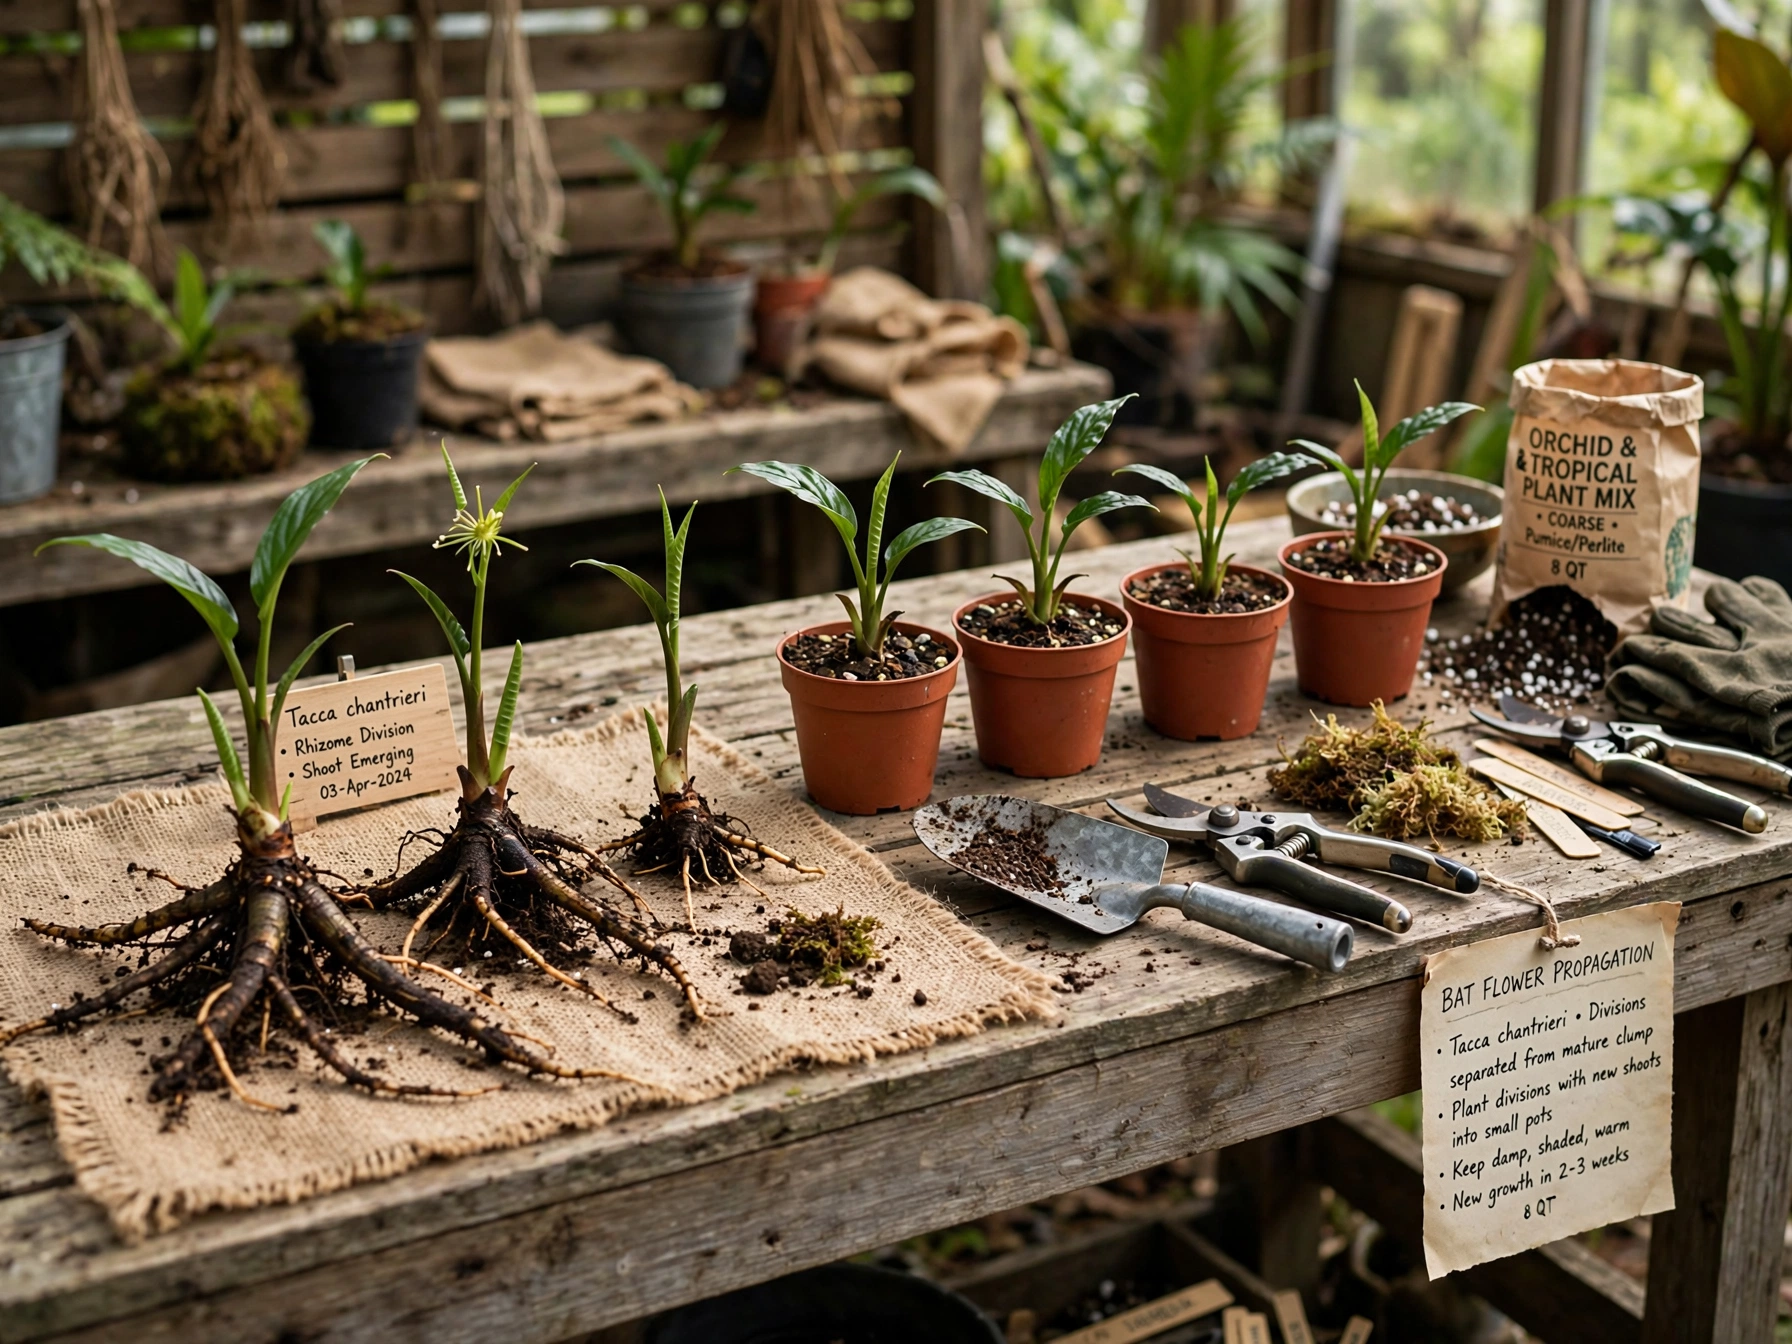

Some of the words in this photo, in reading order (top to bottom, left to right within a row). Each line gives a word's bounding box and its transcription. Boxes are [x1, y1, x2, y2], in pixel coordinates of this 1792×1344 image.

[1529, 427, 1613, 457] ORCHID
[1620, 436, 1637, 458] &
[1530, 453, 1637, 484] TROPICAL
[1523, 477, 1588, 507] PLANT
[1594, 487, 1637, 509] MIX
[1548, 511, 1605, 531] COARSE
[1525, 527, 1625, 554] Pumice/Perlite
[1551, 559, 1560, 575] 8
[1565, 560, 1587, 579] QT
[285, 706, 338, 728] Tacca
[346, 684, 427, 717] chantrieri
[295, 735, 353, 756] Rhizome
[360, 722, 414, 743] Division
[302, 757, 343, 779] Shoot
[350, 746, 414, 769] Emerging
[320, 767, 412, 799] 03-Apr-2024
[1441, 982, 1476, 1013] BAT
[1482, 966, 1544, 1000] FLOWER
[1553, 941, 1655, 984] PROPAGATION
[1449, 1034, 1490, 1056] Tacca
[1497, 1009, 1568, 1044] chantrieri
[1588, 996, 1646, 1022] Divisions
[1449, 1052, 1517, 1091] separated
[1524, 1048, 1555, 1069] from
[1562, 1037, 1609, 1058] mature
[1616, 1025, 1654, 1045] clump
[1452, 1094, 1489, 1121] Plant
[1495, 1083, 1551, 1110] divisions
[1558, 1069, 1586, 1091] with
[1592, 1067, 1618, 1083] new
[1623, 1051, 1661, 1076] shoots
[1452, 1127, 1477, 1148] into
[1485, 1113, 1518, 1139] small
[1525, 1106, 1553, 1135] pots
[1452, 1160, 1485, 1180] Keep
[1492, 1147, 1532, 1168] damp,
[1538, 1124, 1589, 1155] shaded,
[1595, 1119, 1630, 1138] warm
[1453, 1190, 1482, 1211] New
[1488, 1171, 1533, 1209] growth
[1540, 1169, 1552, 1184] in
[1559, 1157, 1586, 1180] 2-3
[1592, 1146, 1630, 1170] weeks
[1523, 1204, 1531, 1220] 8
[1536, 1196, 1557, 1217] QT
